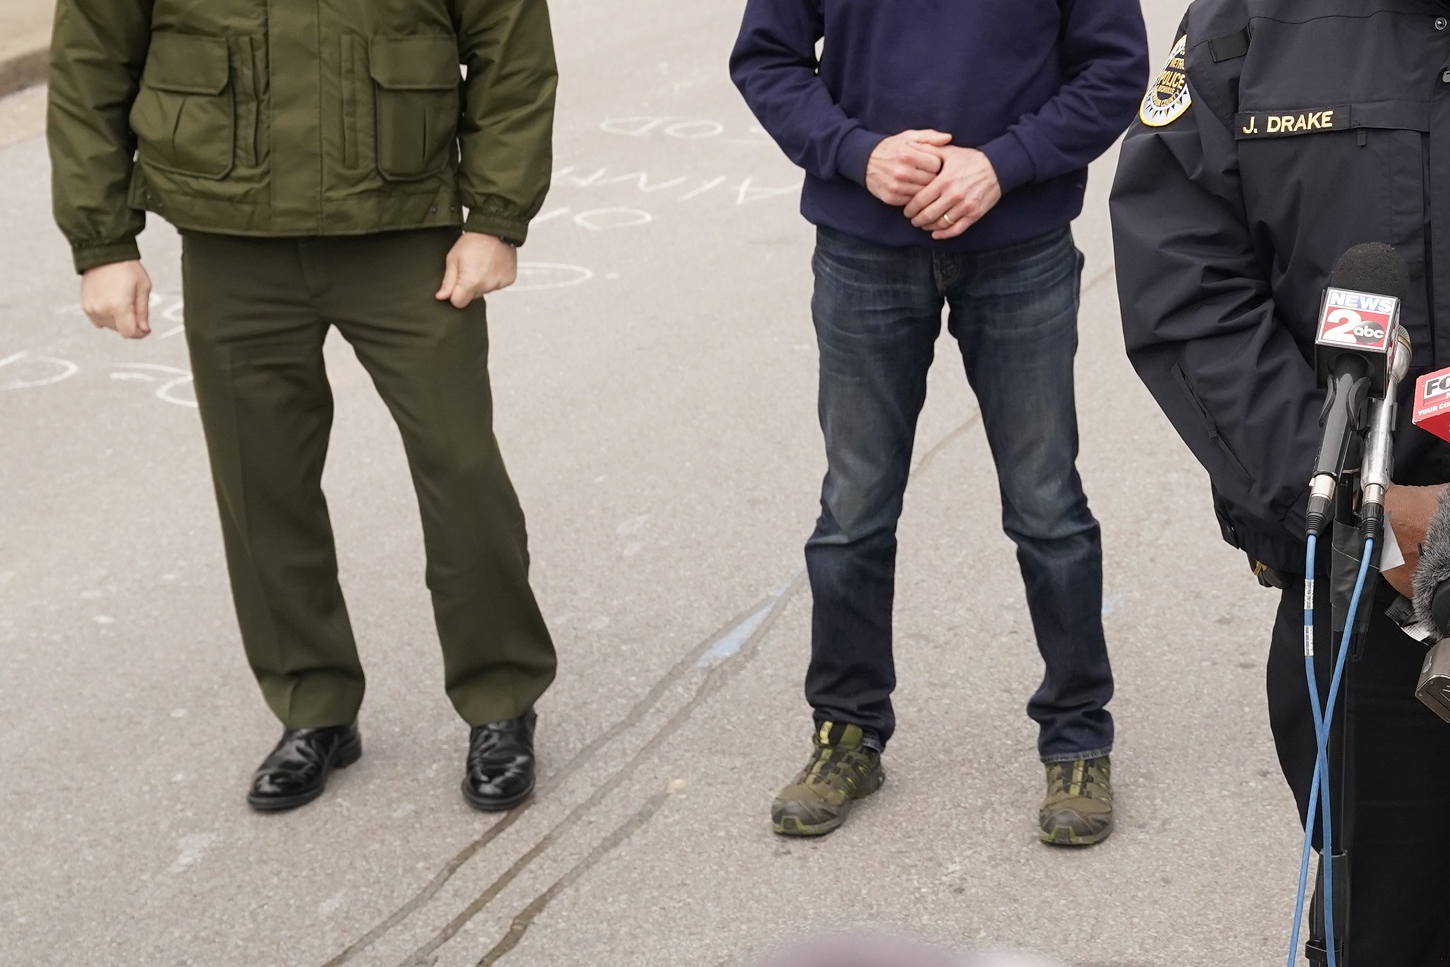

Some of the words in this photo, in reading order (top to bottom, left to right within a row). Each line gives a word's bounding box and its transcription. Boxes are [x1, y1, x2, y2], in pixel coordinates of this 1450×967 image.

[1157, 70, 1185, 90] POLICE
[1242, 116, 1258, 134] J.
[1266, 110, 1334, 132] DRAKE
[1330, 292, 1393, 313] NEWS
[1322, 309, 1362, 343] 2
[1353, 325, 1384, 339] abc
[1417, 405, 1438, 416] YOUR
